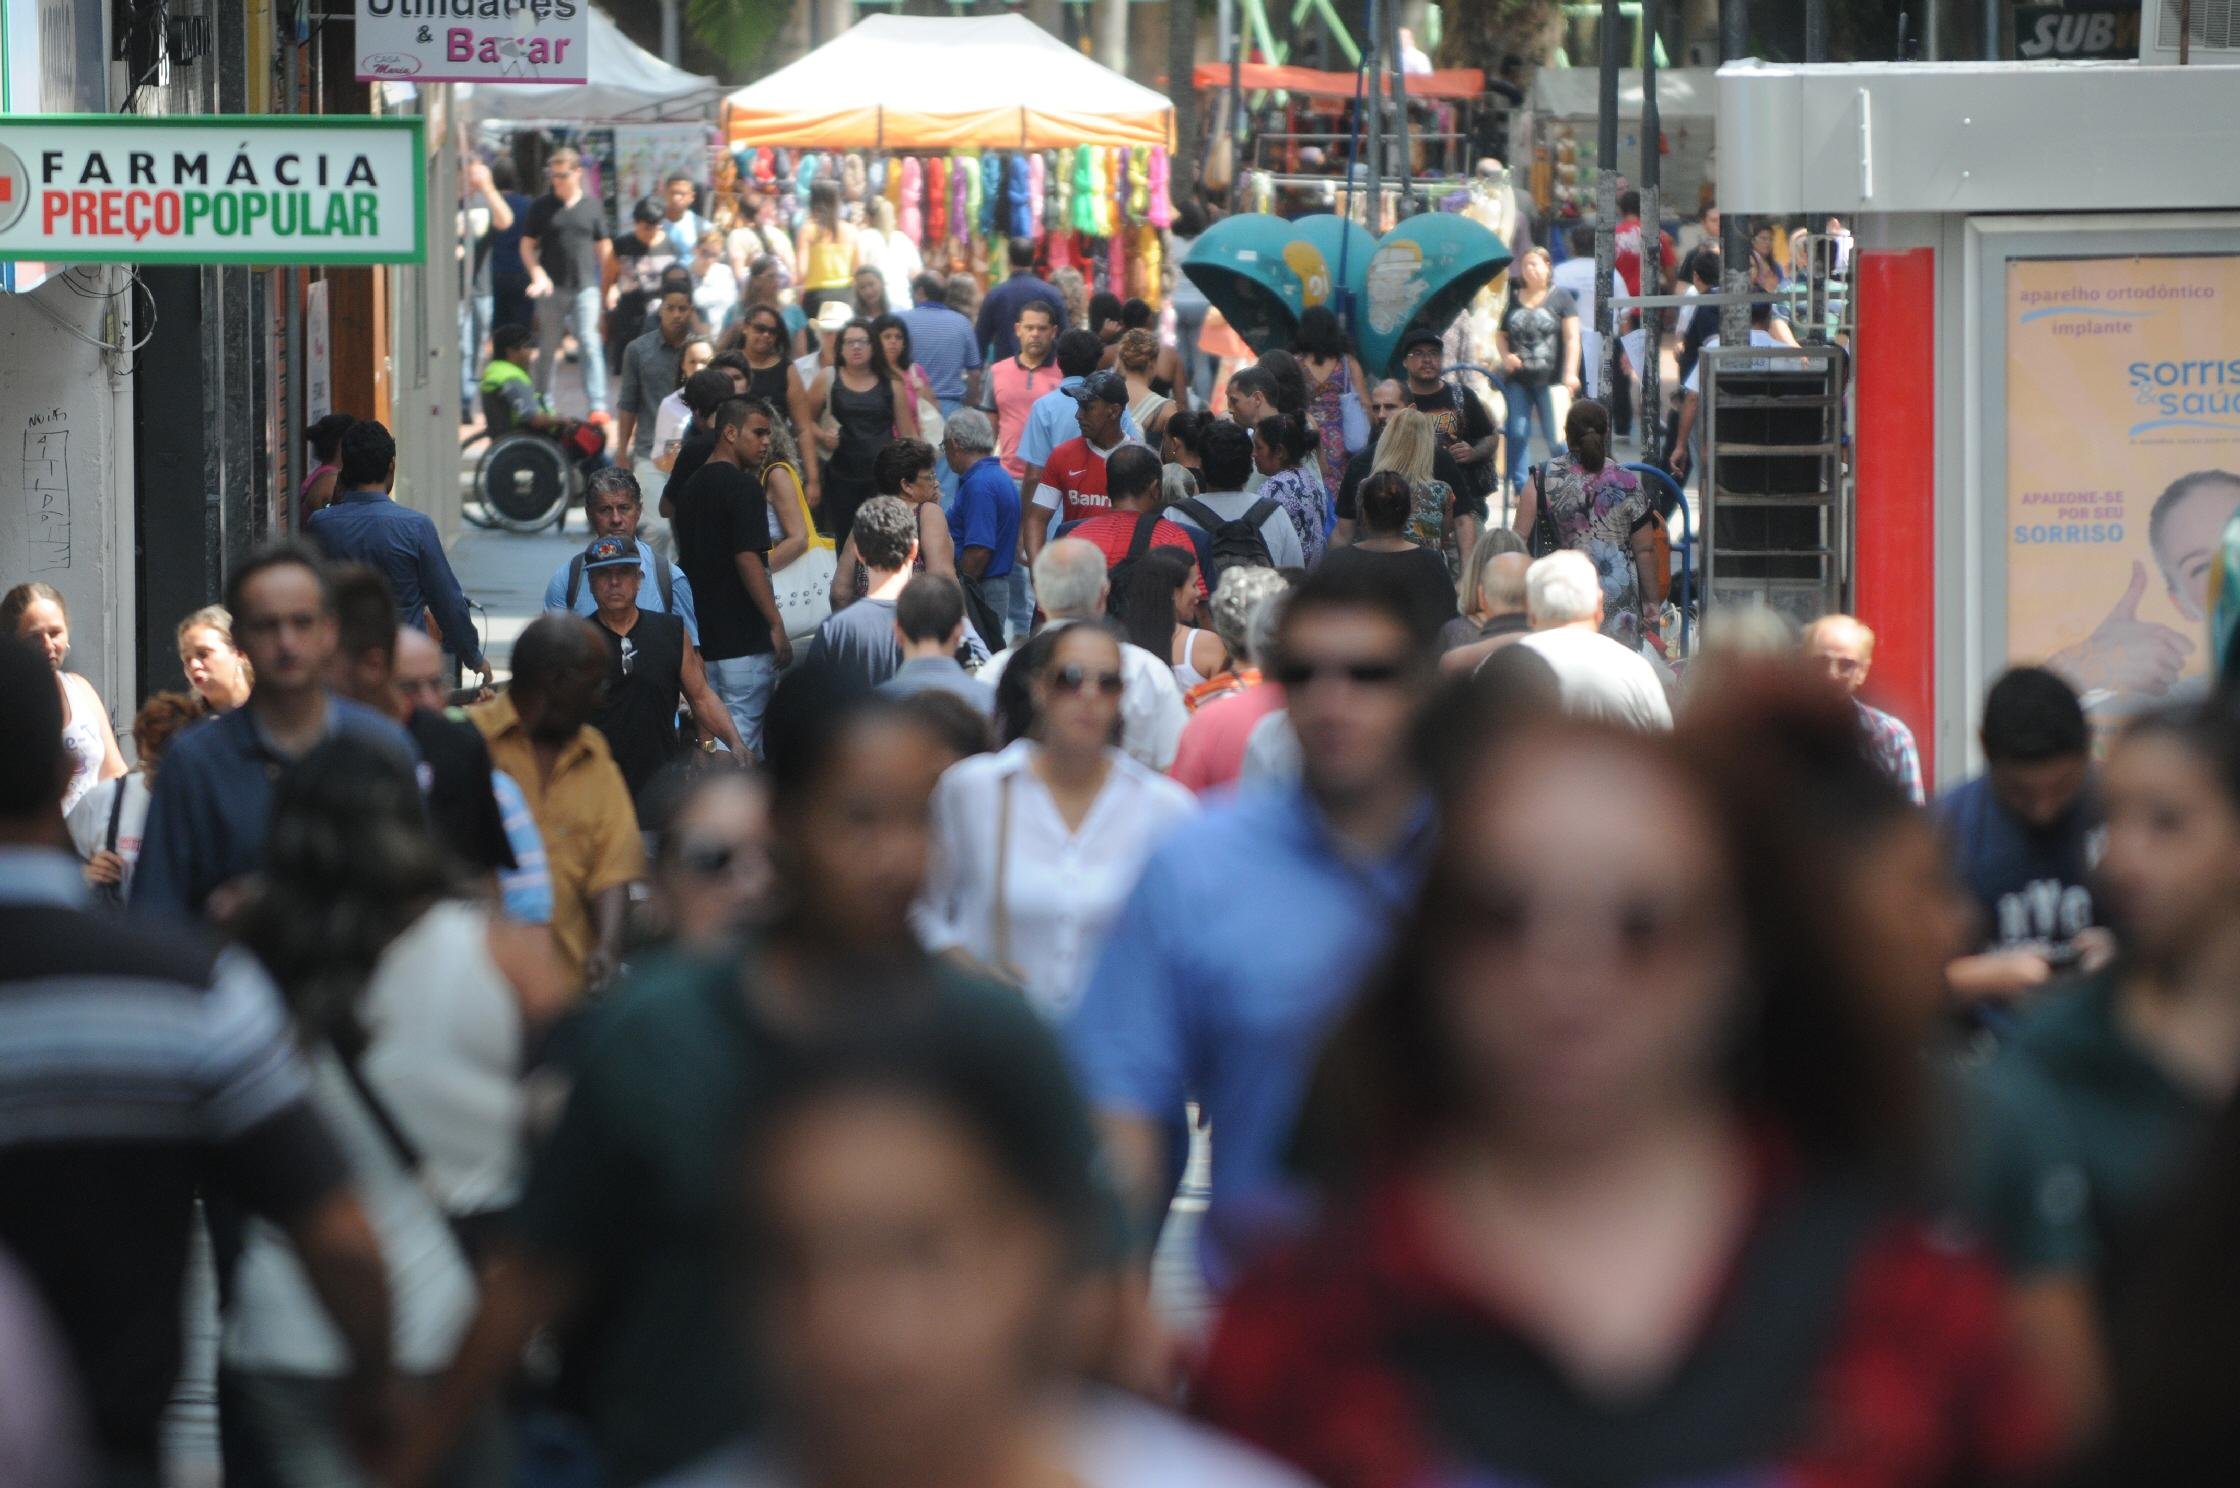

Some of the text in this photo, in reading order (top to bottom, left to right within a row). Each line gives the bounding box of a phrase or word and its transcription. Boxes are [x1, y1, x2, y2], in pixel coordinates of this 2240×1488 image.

[416, 25, 571, 64] & Baar
[42, 142, 378, 186] FARMÁCIA
[2020, 283, 2215, 304] aparelho ortodôntico
[2051, 320, 2133, 338] implante
[2021, 490, 2124, 505] APAIXONE-SE
[2058, 506, 2124, 520] POR SEU
[2014, 523, 2124, 544] SORRISO
